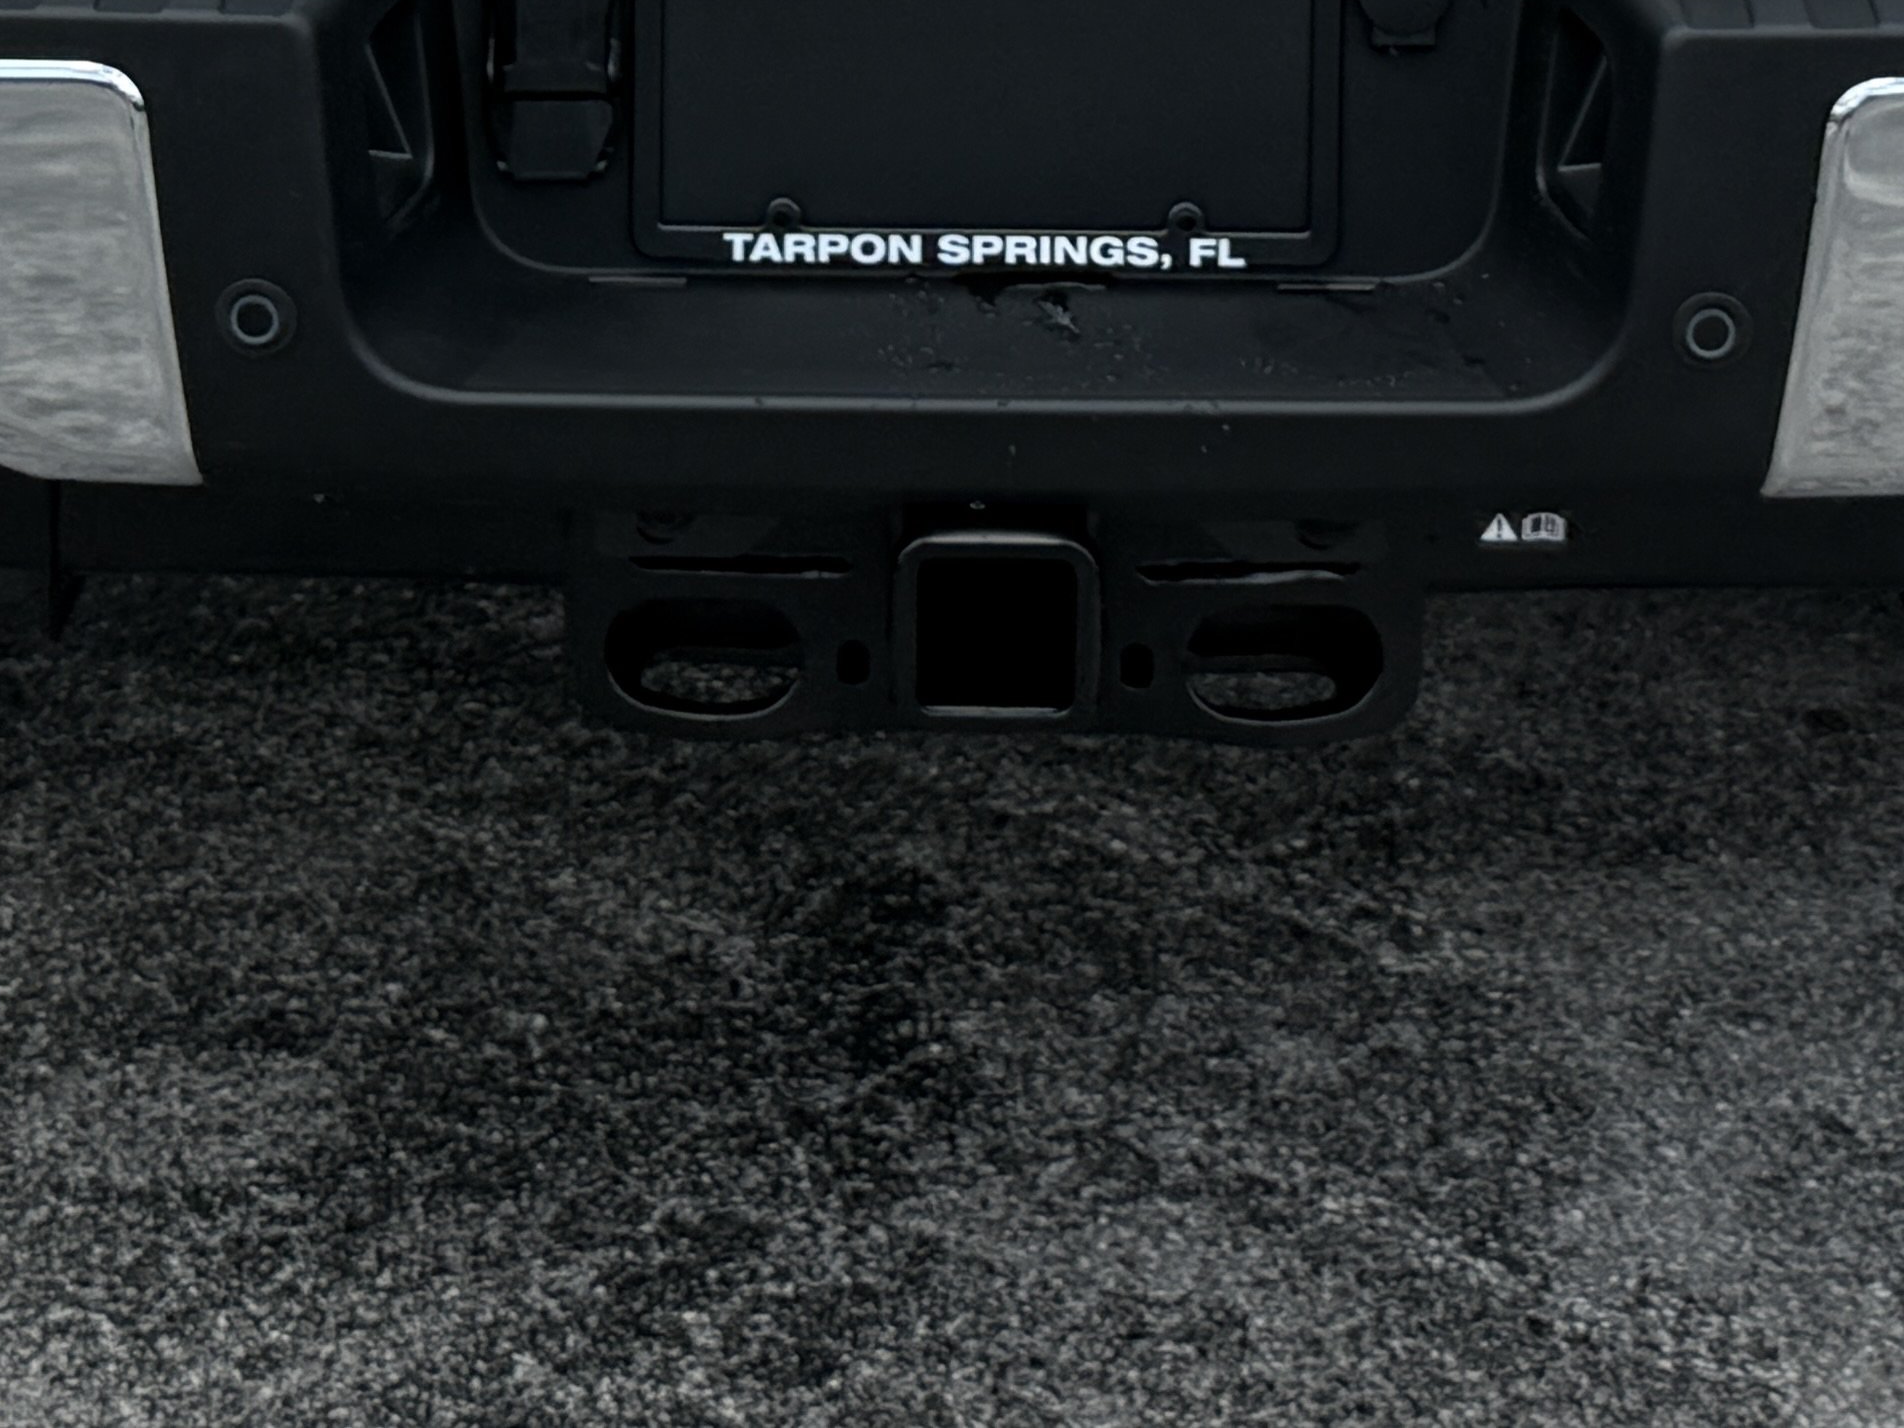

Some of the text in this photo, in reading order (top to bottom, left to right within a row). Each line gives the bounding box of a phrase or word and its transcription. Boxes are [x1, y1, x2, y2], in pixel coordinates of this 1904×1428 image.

[722, 232, 1247, 271] TARPON SPRINGS, FL
